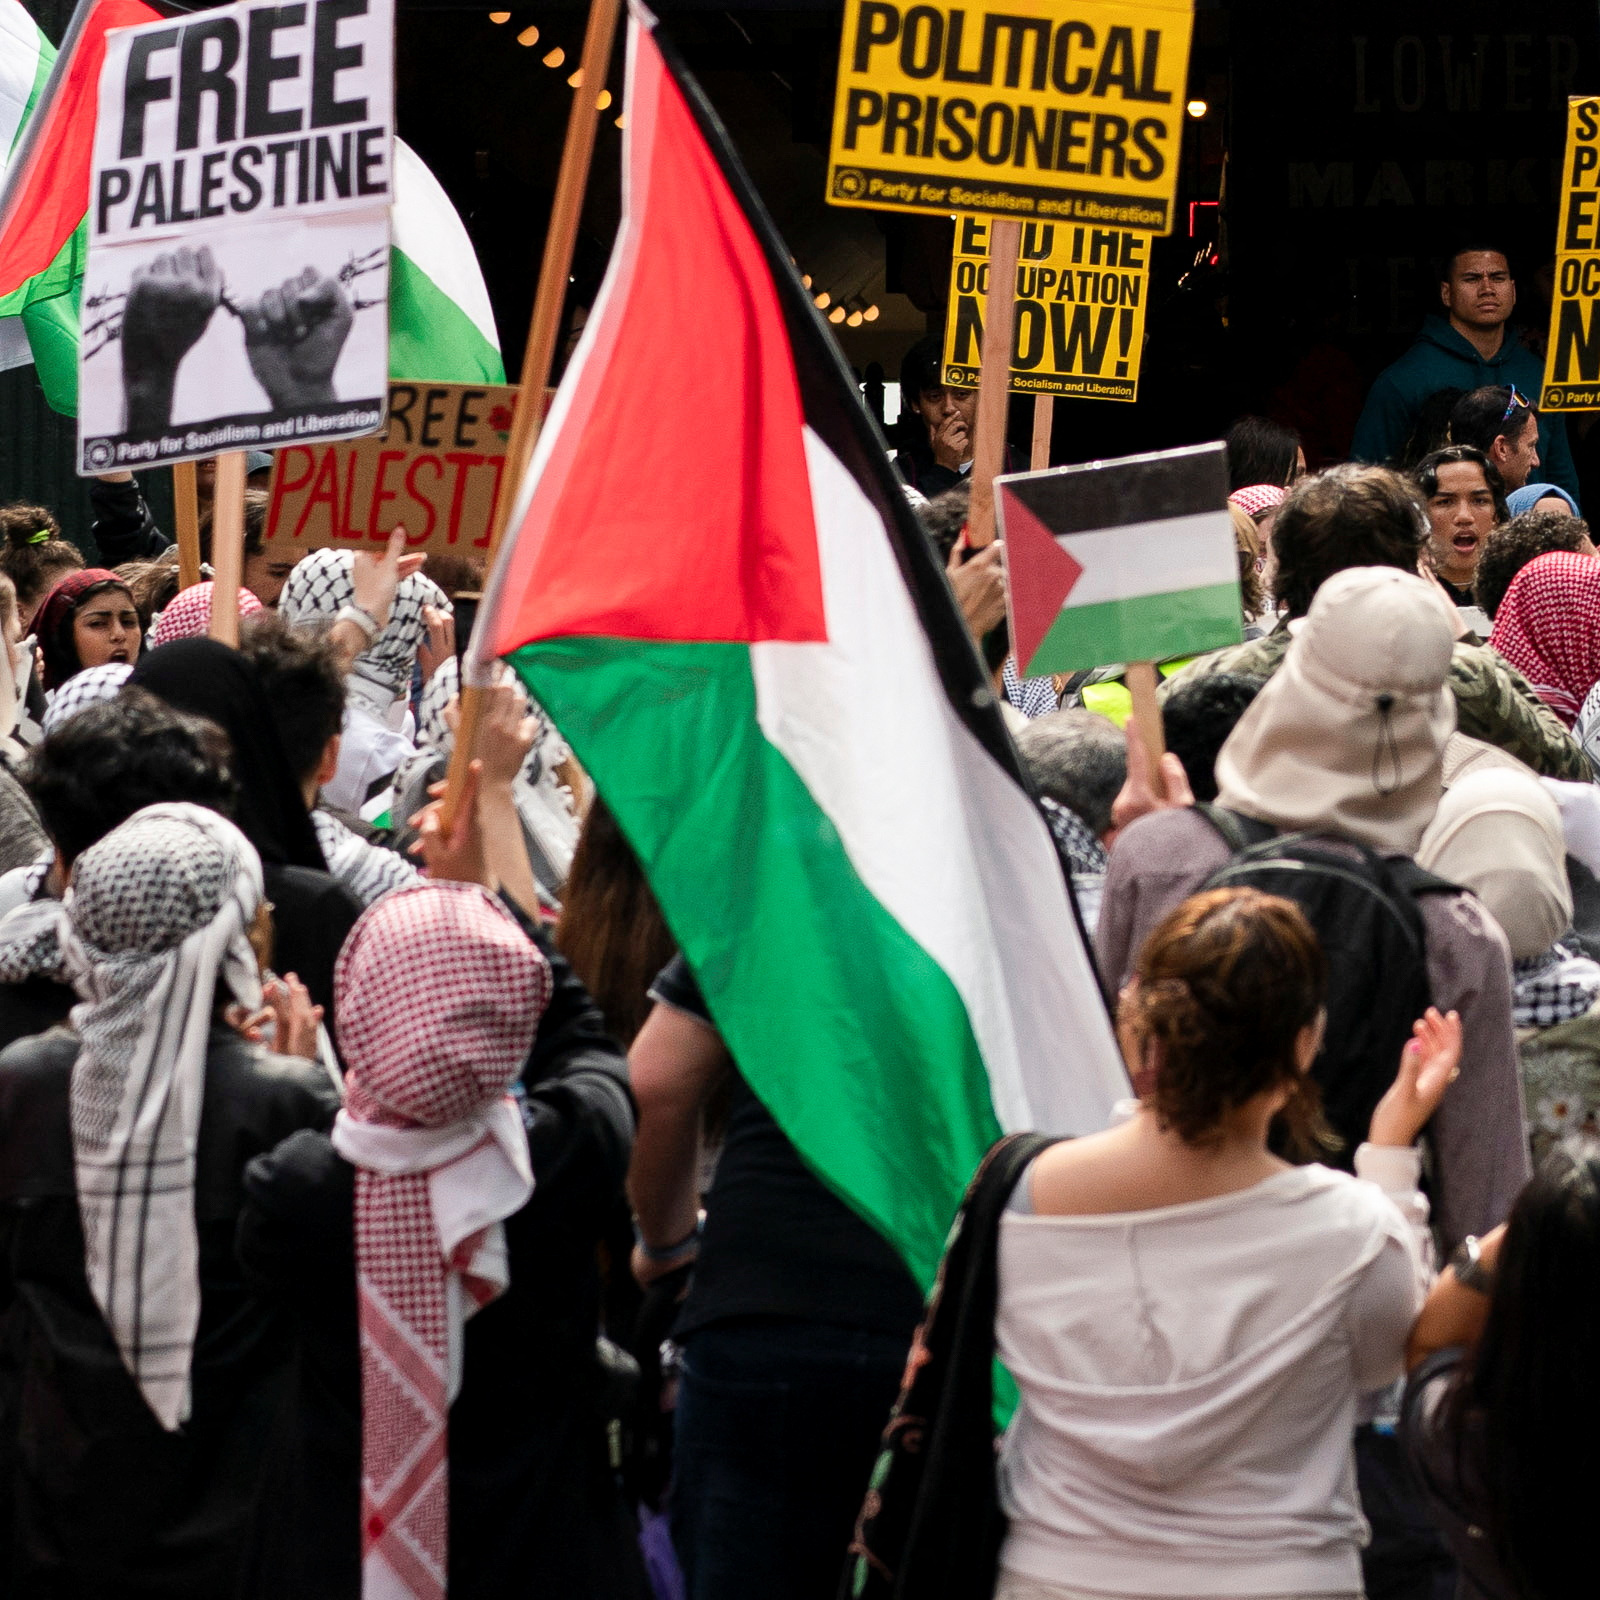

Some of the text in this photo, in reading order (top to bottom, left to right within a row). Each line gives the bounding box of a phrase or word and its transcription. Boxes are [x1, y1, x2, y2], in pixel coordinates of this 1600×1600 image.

[851, 0, 1174, 105] POLITICAL
[842, 87, 1168, 183] PRISONERS
[96, 126, 388, 235] PALESTINE
[1286, 157, 1566, 209] MARK
[1037, 197, 1072, 216] and
[960, 216, 1054, 261] ED
[956, 261, 1141, 308] OCUPATION
[952, 295, 1135, 378] NOW!
[1013, 374, 1063, 391] Socialism
[1065, 381, 1084, 392] and
[1087, 382, 1132, 396] Liberation
[1566, 391, 1594, 406] Party
[116, 438, 160, 463] Party
[159, 434, 185, 456] for
[262, 416, 295, 441] and
